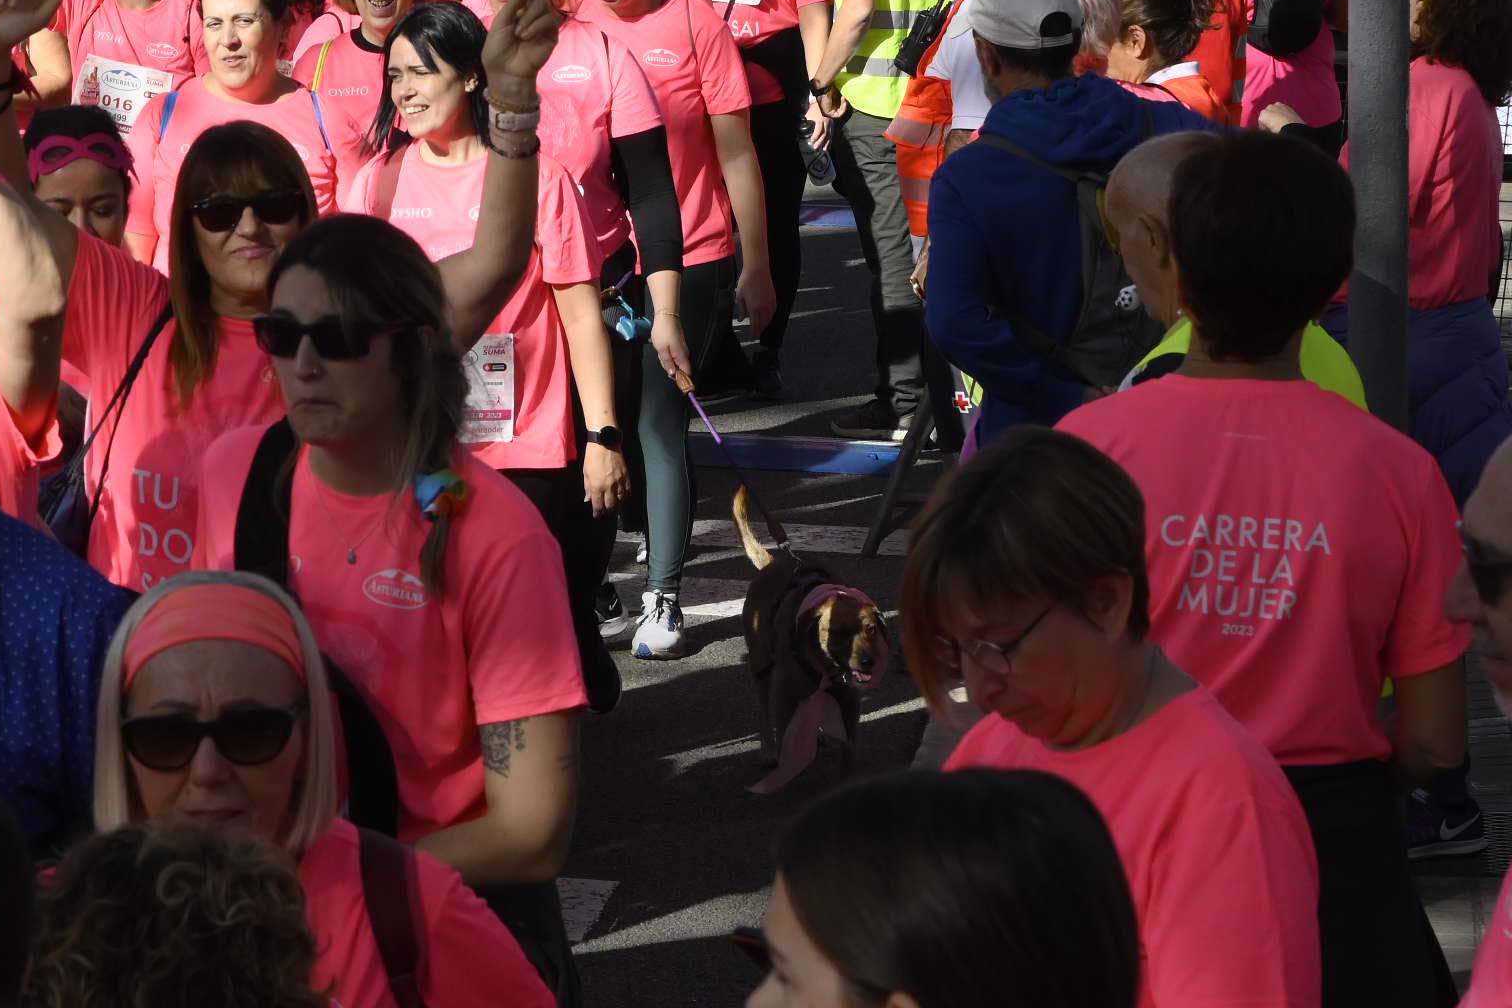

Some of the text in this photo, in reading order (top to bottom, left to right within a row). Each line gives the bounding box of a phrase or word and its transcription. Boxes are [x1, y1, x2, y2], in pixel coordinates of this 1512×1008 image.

[103, 74, 139, 90] ASTURIANA
[327, 86, 369, 97] OYSHO
[101, 94, 133, 112] 016
[390, 206, 432, 218] OYSHO
[482, 347, 507, 356] SUMA
[131, 468, 180, 511] TU
[138, 522, 194, 565] DO
[1160, 513, 1333, 556] CARRERA
[1190, 549, 1294, 586] DE LA
[1175, 581, 1298, 621] MUJER
[1221, 622, 1256, 637] 2023
